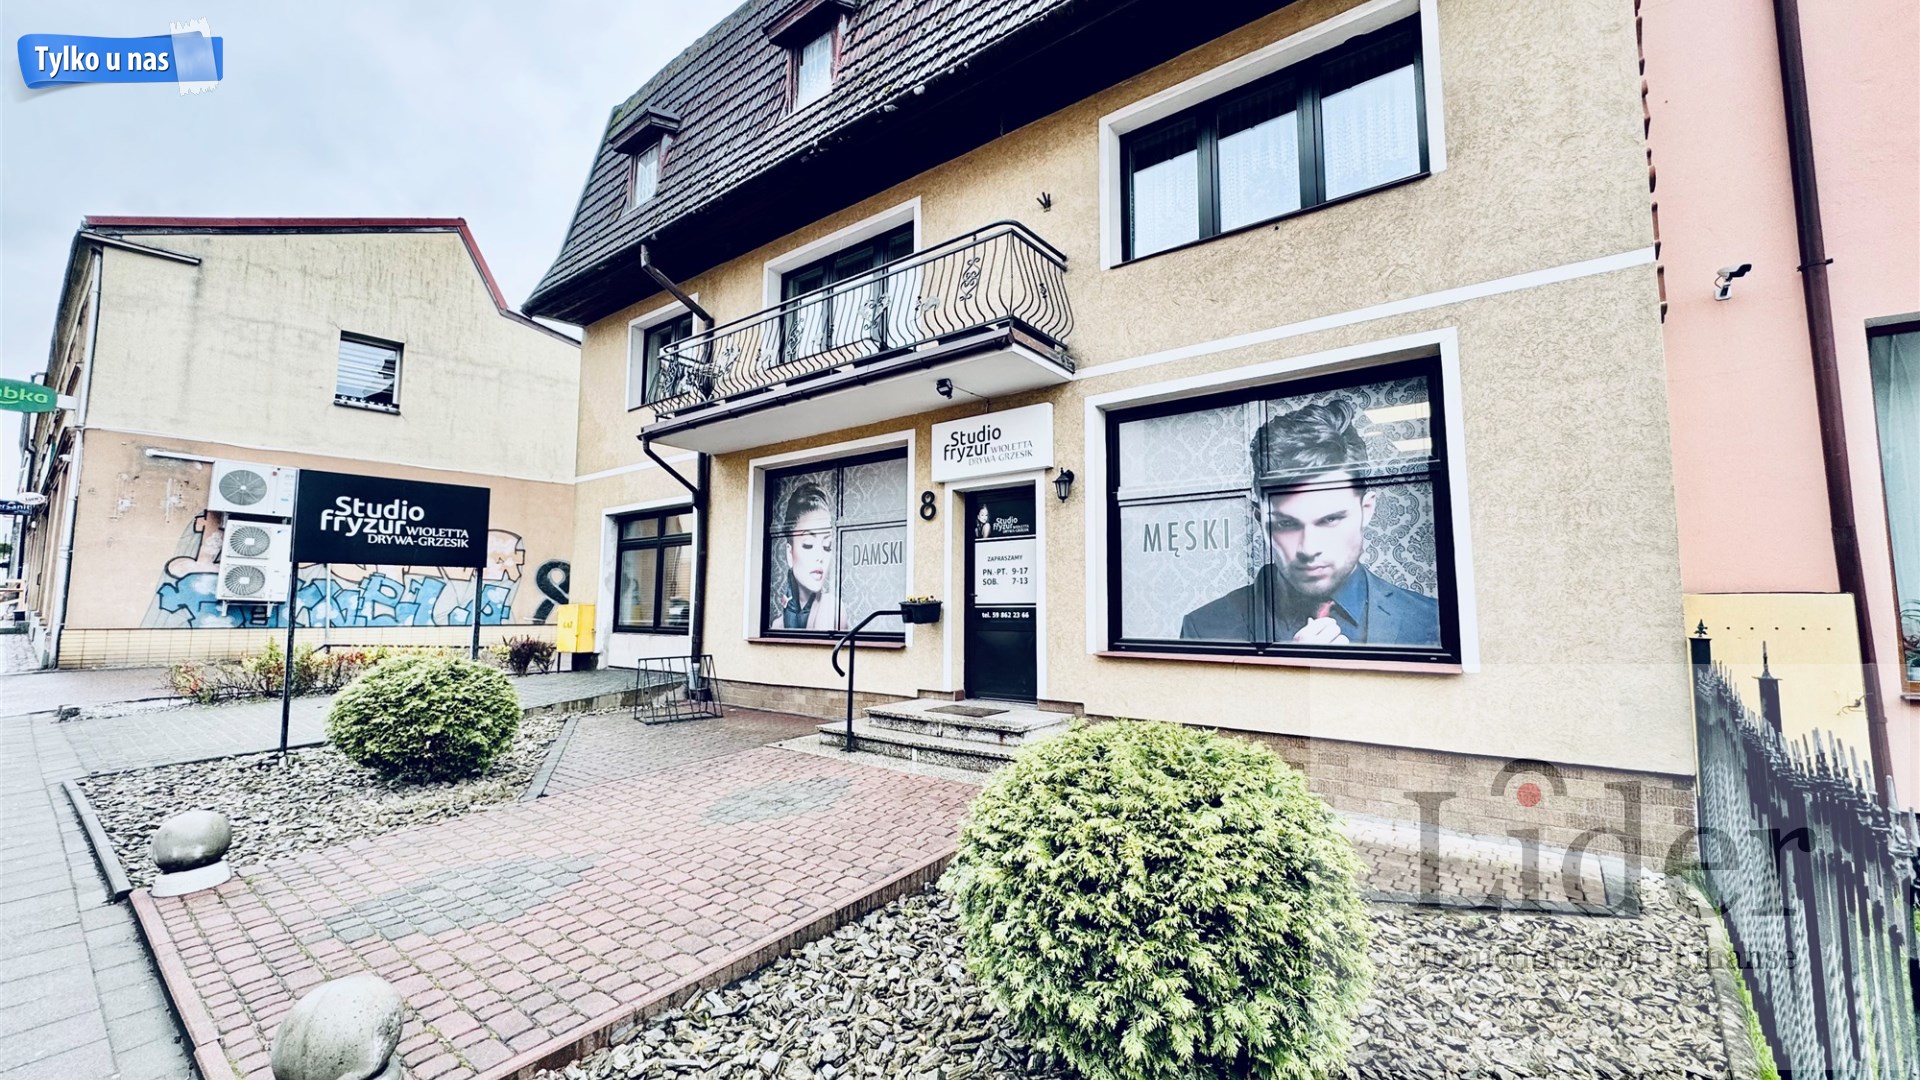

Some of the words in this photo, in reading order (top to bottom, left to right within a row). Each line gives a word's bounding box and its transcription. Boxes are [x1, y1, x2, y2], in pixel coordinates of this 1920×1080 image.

[0, 386, 49, 404] bka
[951, 425, 1001, 447] Studio
[943, 442, 990, 463] fryzur
[990, 440, 1033, 454] WIOLETTA
[335, 495, 425, 522] Studio
[920, 491, 936, 520] 8
[320, 509, 407, 537] fryzur
[405, 526, 469, 539] WIOLETTA
[367, 534, 469, 549] DRYWA-GRZESIK
[1143, 518, 1229, 557] MĘSKI
[852, 541, 903, 566] DAMSKI
[1011, 567, 1029, 575] 9-17
[1012, 577, 1029, 585] 7-13
